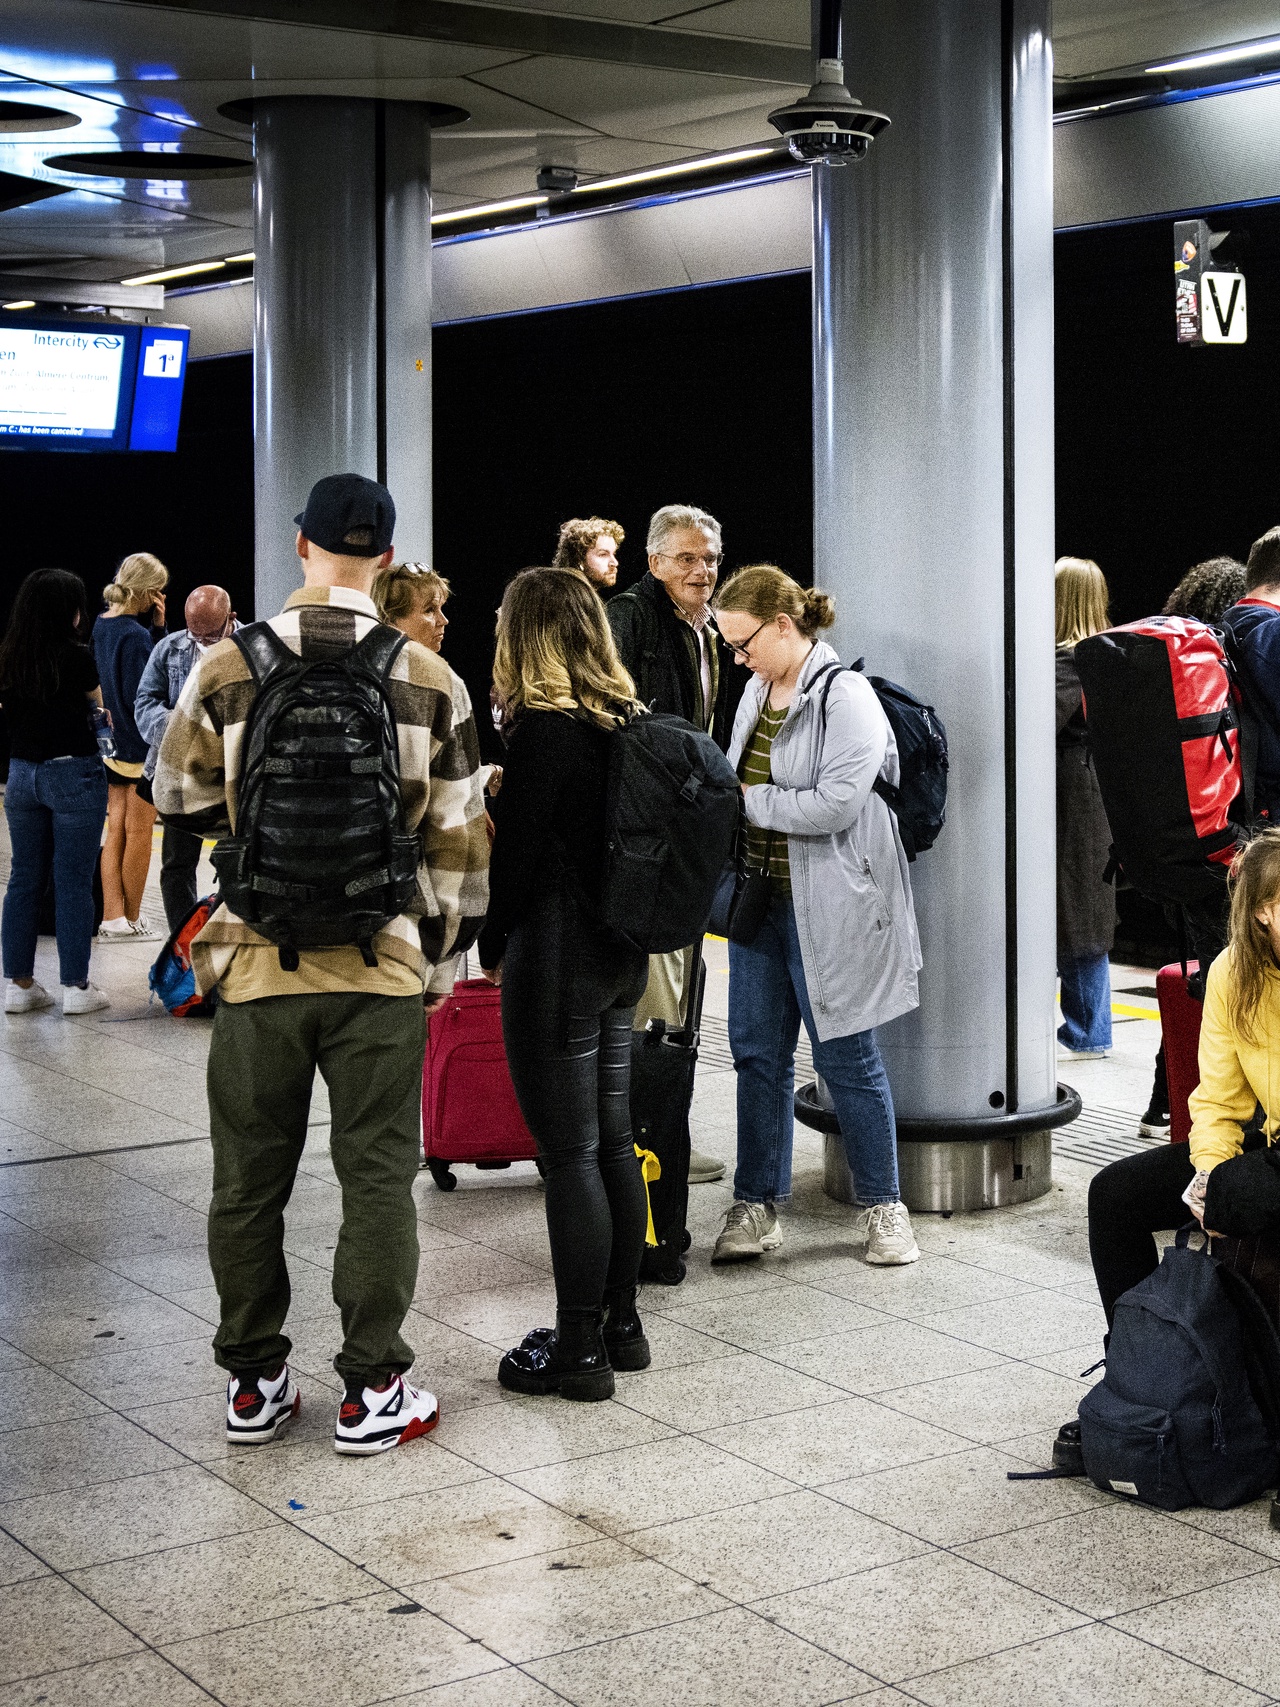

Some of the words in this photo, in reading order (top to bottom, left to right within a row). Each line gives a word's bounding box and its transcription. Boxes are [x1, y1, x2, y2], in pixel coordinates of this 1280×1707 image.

[1206, 278, 1242, 337] V
[34, 333, 89, 351] Intercity
[19, 425, 31, 434] has
[32, 427, 50, 435] been
[51, 428, 83, 436] cancelled
